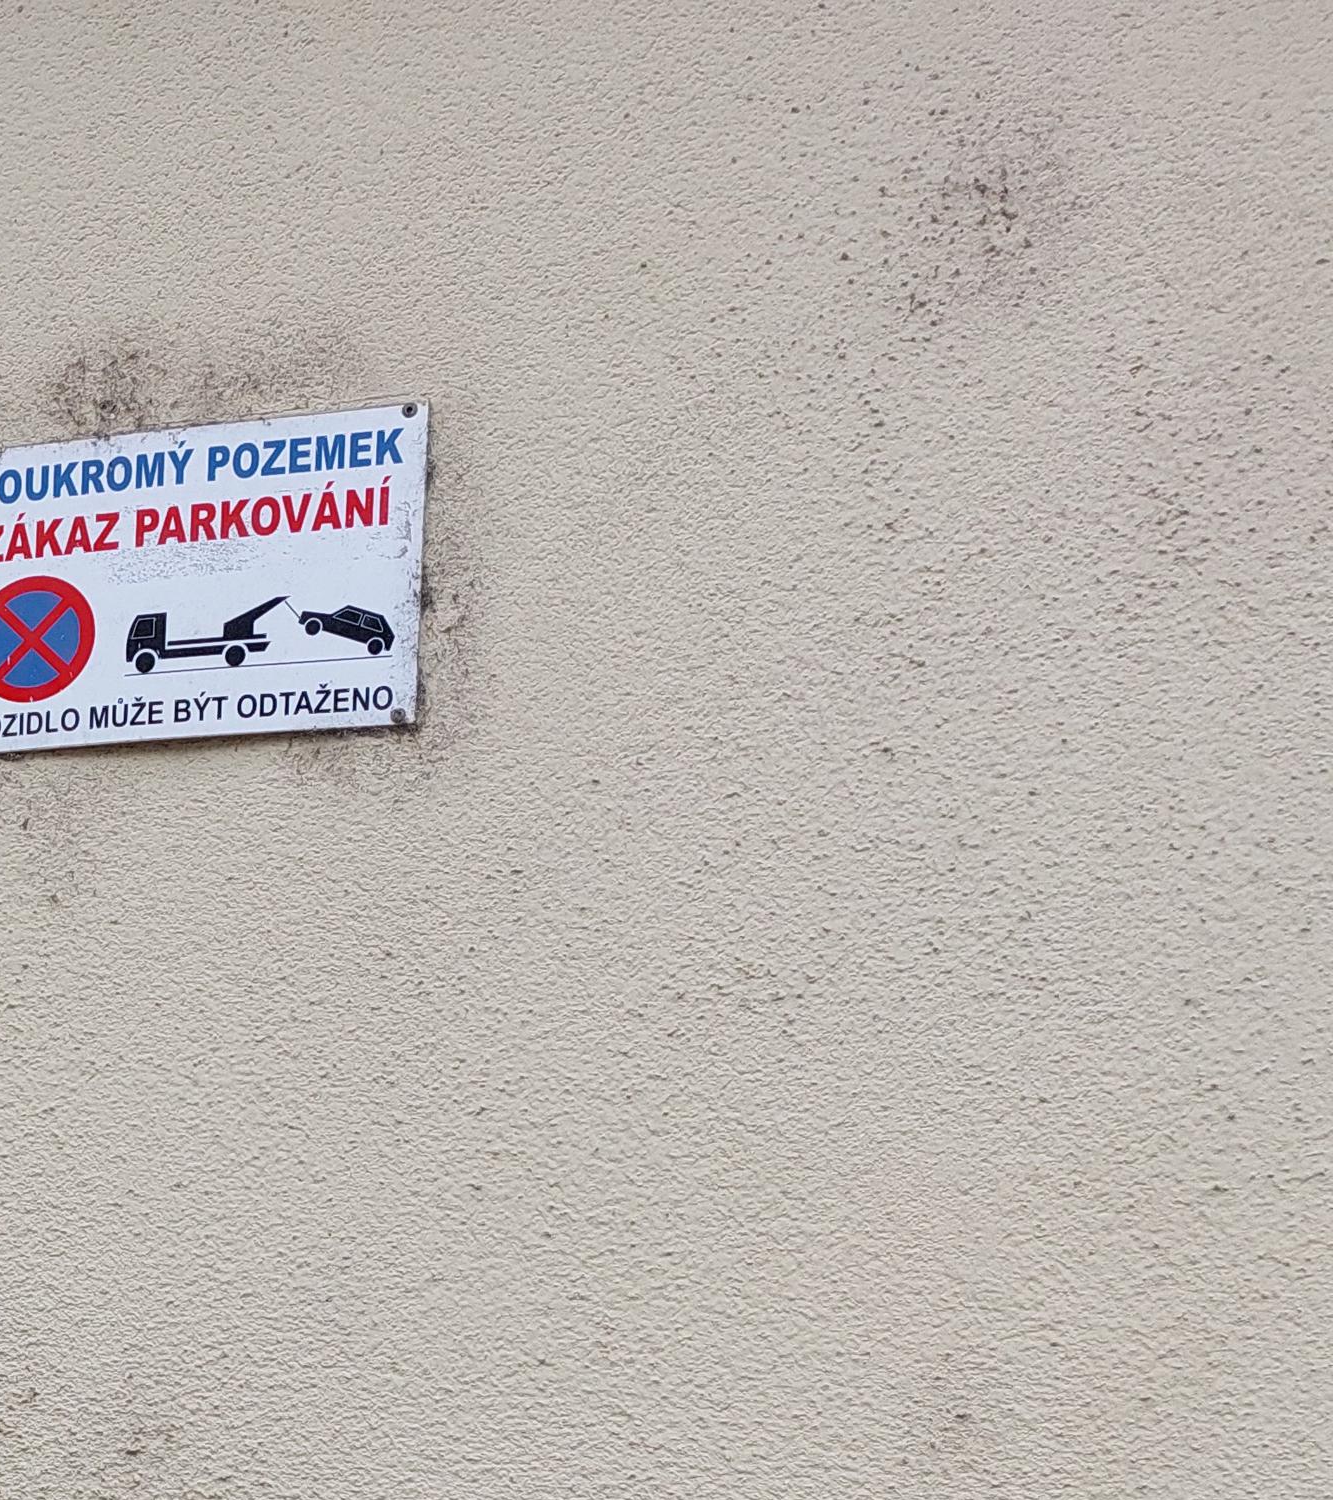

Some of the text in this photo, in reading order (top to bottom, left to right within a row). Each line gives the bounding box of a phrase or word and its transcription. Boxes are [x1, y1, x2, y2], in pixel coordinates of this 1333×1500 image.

[207, 427, 404, 482] POZEMEK
[135, 476, 392, 547] PARKOVÁNÍ
[89, 698, 164, 729] MŮŽE
[174, 691, 228, 722] BÝT
[237, 684, 393, 717] ODTAŽENO
